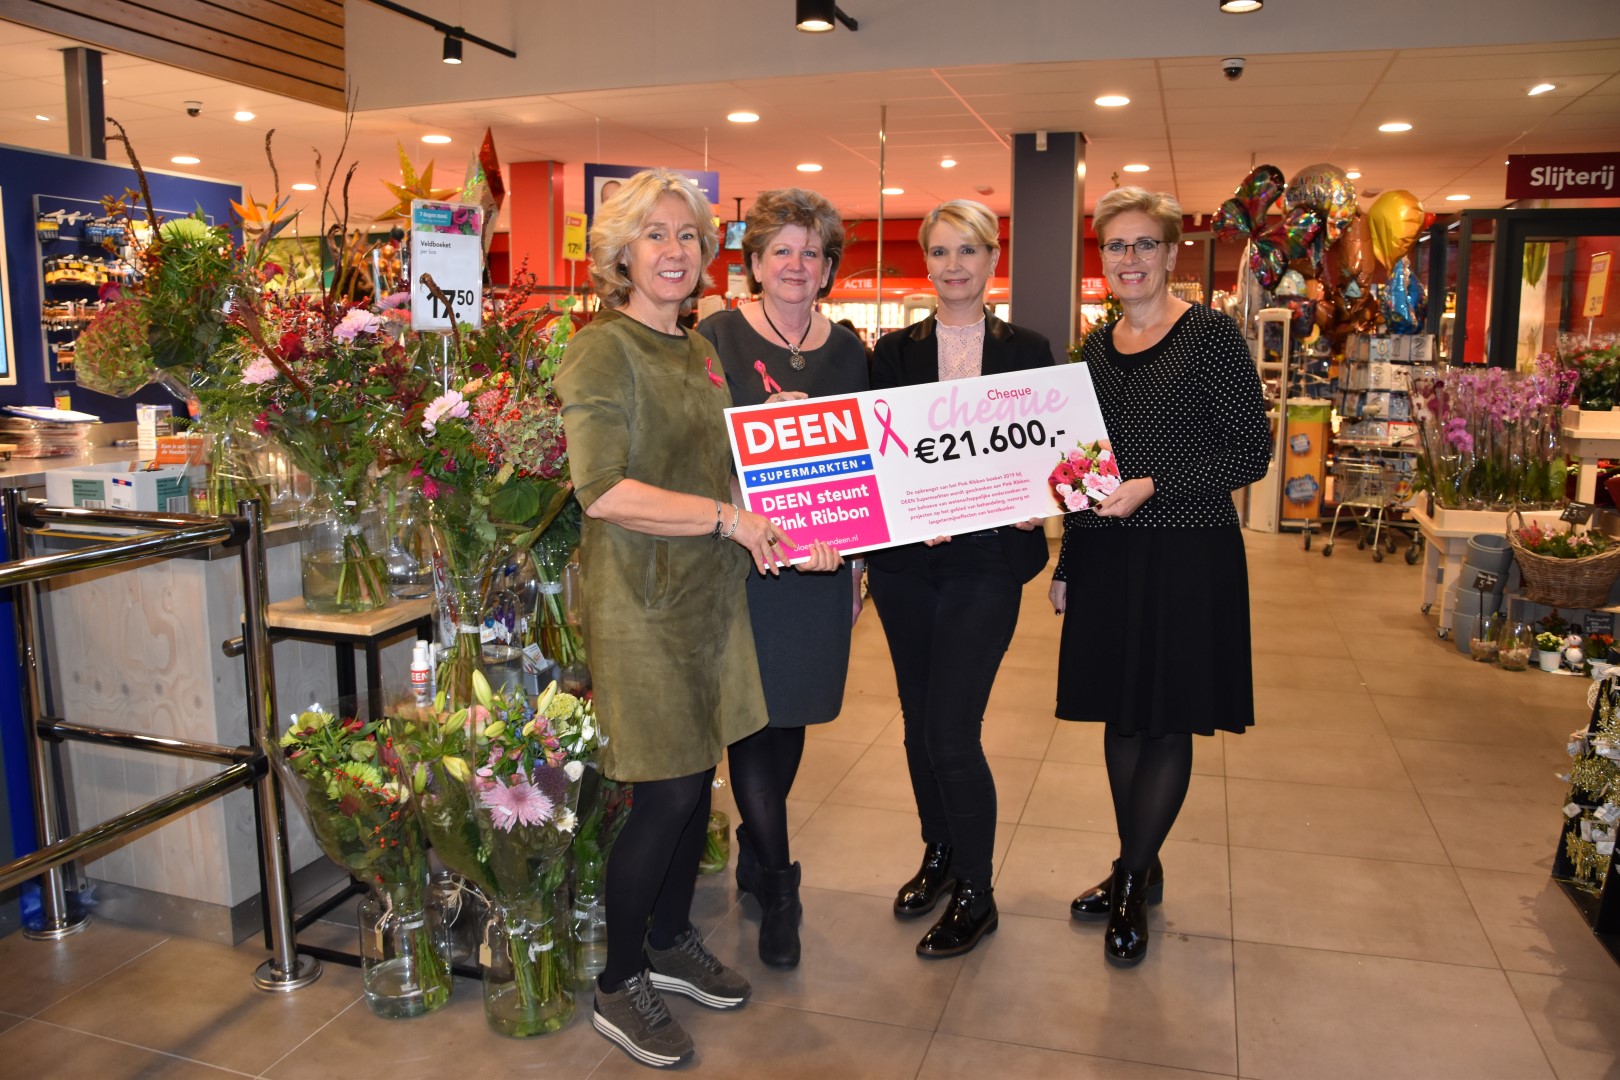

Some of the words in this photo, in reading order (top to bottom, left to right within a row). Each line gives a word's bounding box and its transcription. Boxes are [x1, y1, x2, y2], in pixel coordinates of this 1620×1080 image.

[1530, 165, 1615, 191] Slijterij
[420, 240, 452, 248] Veldboeket
[844, 279, 872, 289] ACTIE
[987, 386, 1032, 400] Cheque
[743, 410, 857, 454] DEEN
[914, 420, 1066, 464] €21.600,-
[760, 460, 858, 482] SUPERMARKTEN
[762, 492, 816, 512] DEEN
[816, 484, 870, 504] steunt
[770, 512, 810, 531] Pink
[811, 505, 870, 525] Ribbon
[411, 672, 428, 681] EEN
